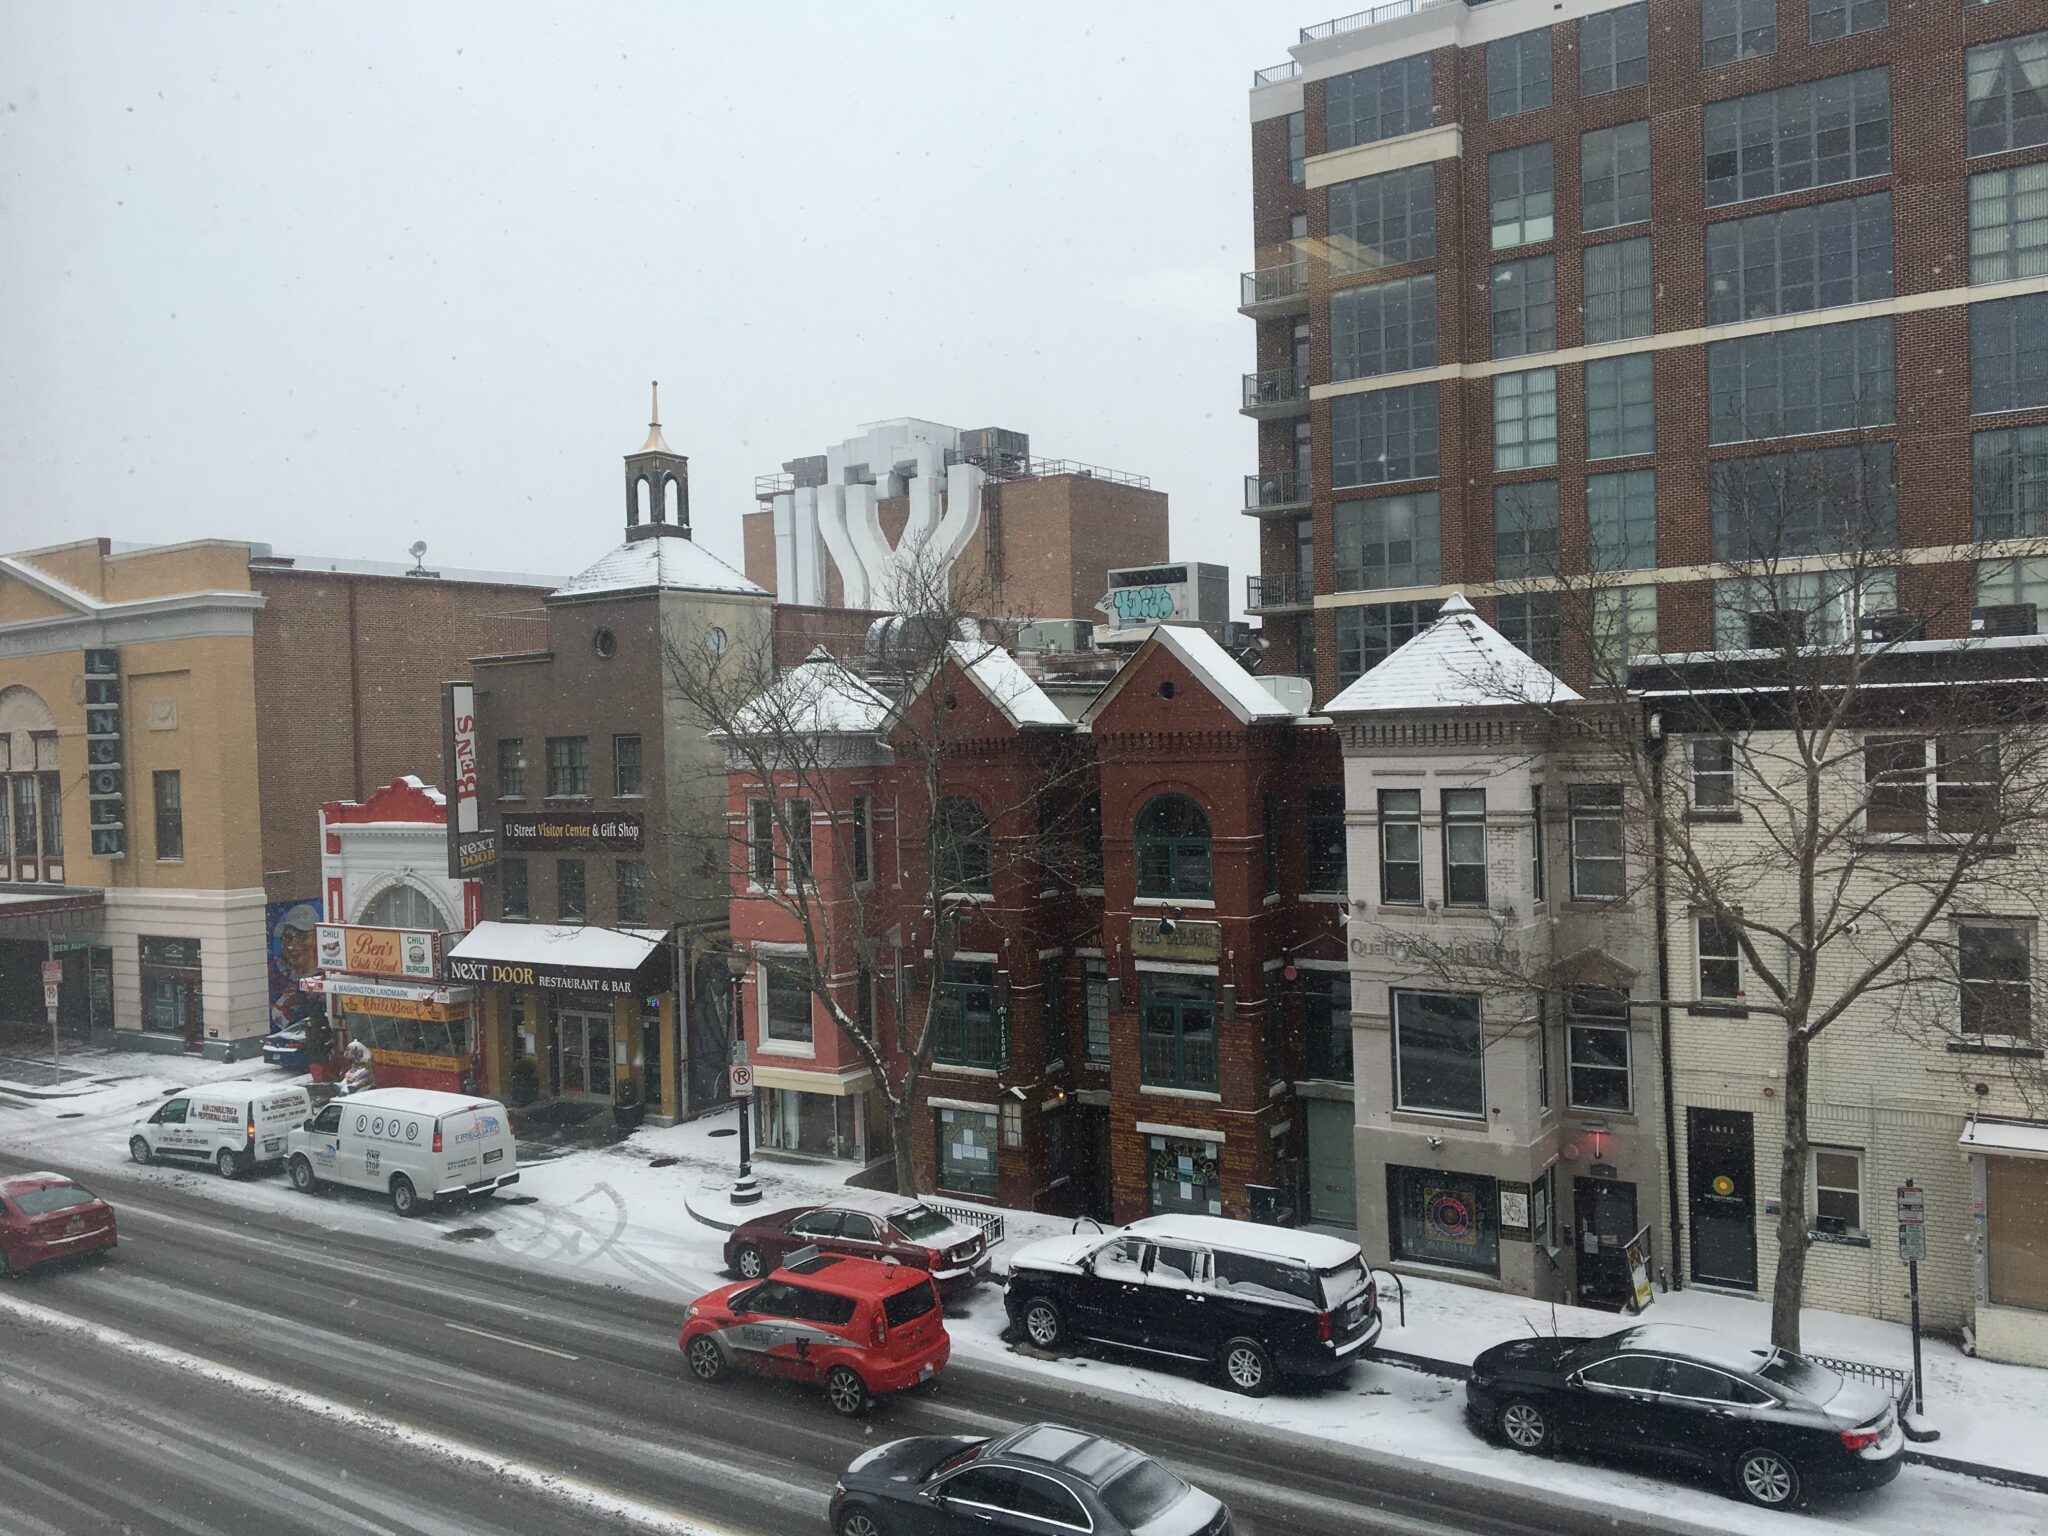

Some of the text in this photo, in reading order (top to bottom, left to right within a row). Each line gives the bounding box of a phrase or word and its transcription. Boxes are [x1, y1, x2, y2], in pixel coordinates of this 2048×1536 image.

[94, 651, 118, 852] LINCOLN
[455, 714, 478, 803] BEN'S
[506, 822, 639, 840] U Street Visitor Center & Gift Shop
[460, 850, 495, 868] DOOR
[322, 929, 339, 938] CHILI
[406, 936, 425, 945] CHILI
[353, 932, 393, 956] Ben's
[321, 958, 343, 967] SMOKES
[351, 955, 398, 972] Chili Bowl
[432, 932, 441, 978] BEN'S
[405, 965, 430, 973] BURGER
[492, 965, 534, 985] DOOR
[539, 976, 599, 991] RESTAURANT
[601, 980, 610, 991] &
[612, 981, 632, 993] BAR
[338, 985, 375, 996] WASHINGTON
[376, 988, 409, 998] LANDMARK
[455, 1125, 500, 1142] FIREGUARD
[366, 1151, 380, 1162] ONE
[366, 1160, 380, 1170] STOP
